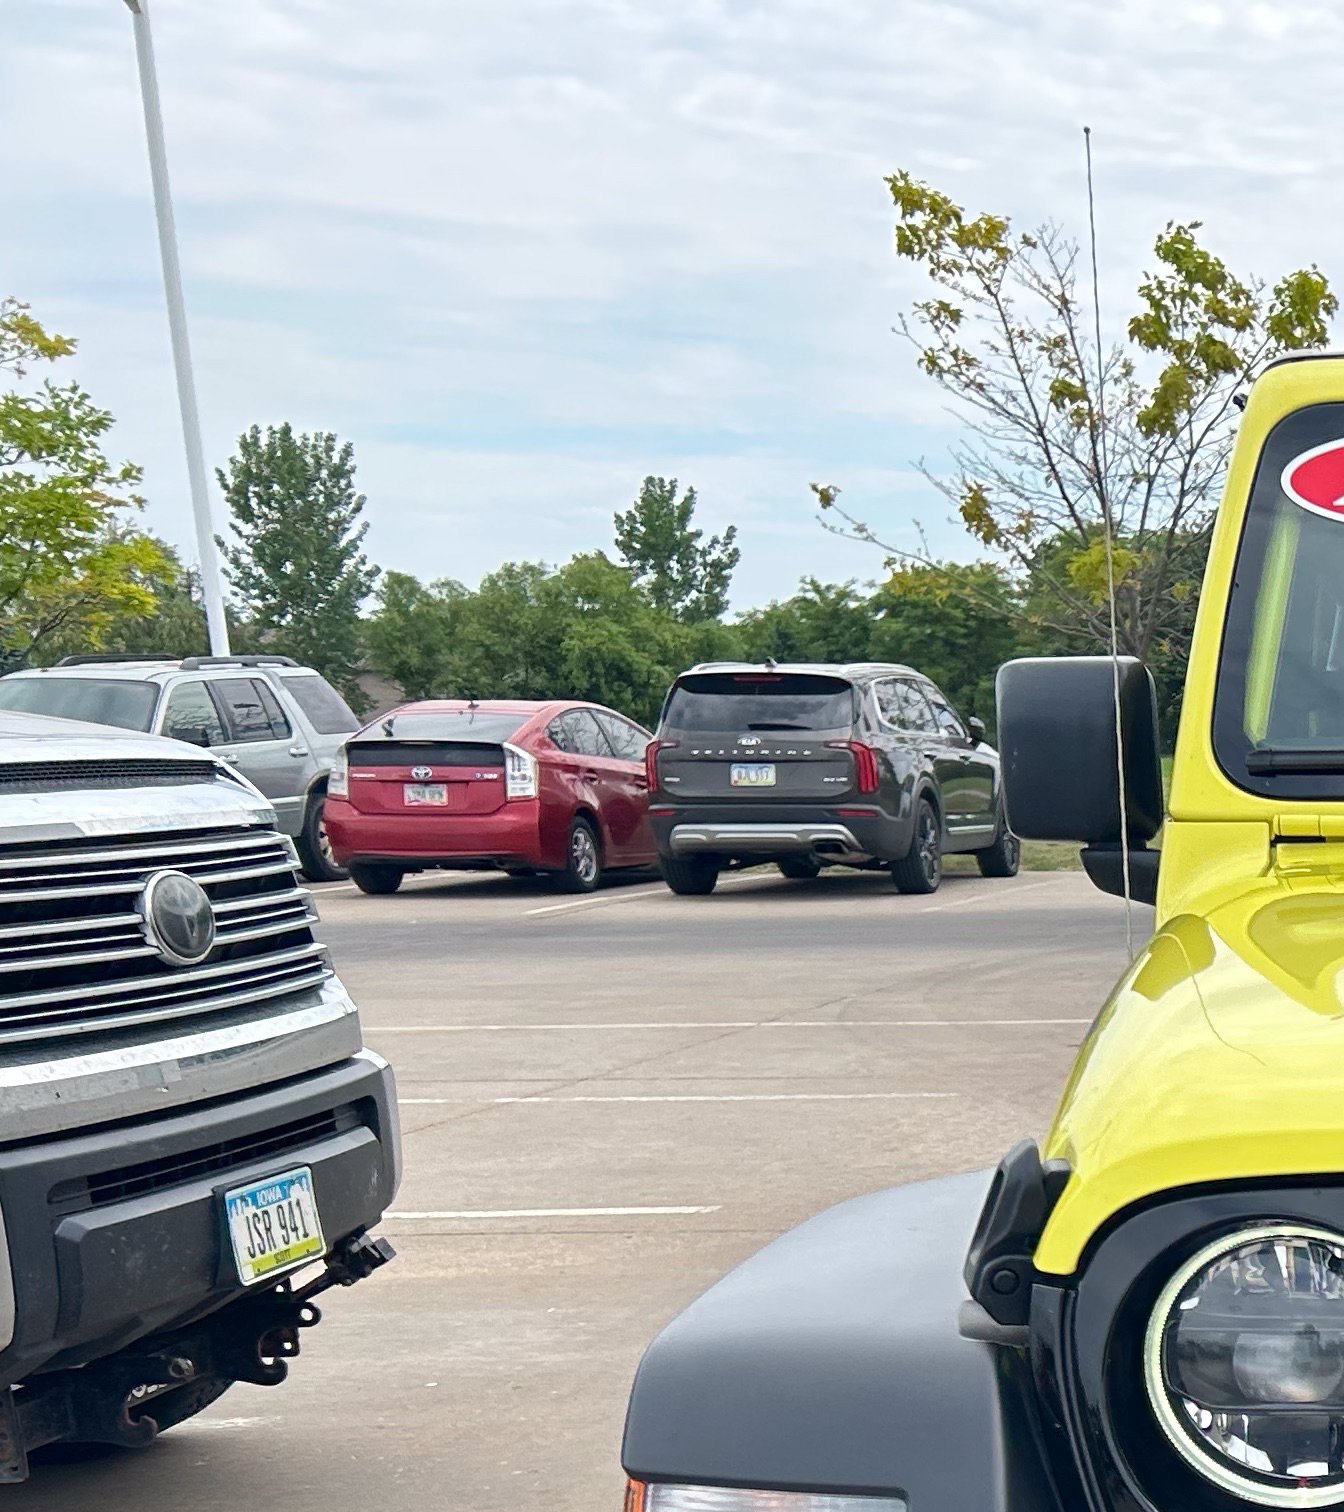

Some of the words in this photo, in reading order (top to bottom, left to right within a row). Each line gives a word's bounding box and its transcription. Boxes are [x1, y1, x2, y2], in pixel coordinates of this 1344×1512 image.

[256, 1185, 283, 1206] IOWA
[246, 1210, 277, 1259] JSR
[277, 1198, 309, 1245] 941
